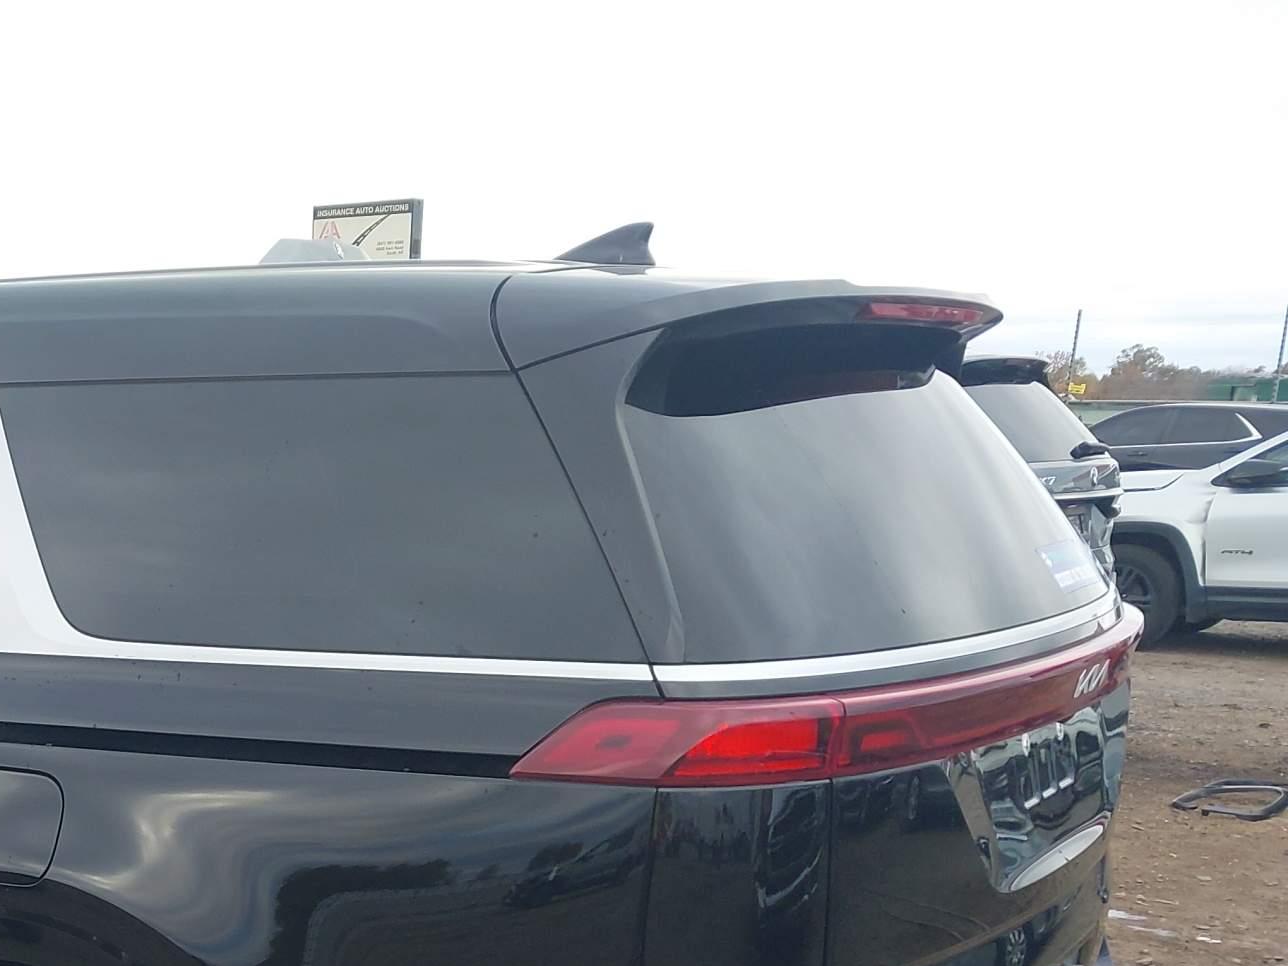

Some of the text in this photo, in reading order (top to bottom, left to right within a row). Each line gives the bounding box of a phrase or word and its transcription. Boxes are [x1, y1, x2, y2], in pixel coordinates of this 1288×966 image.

[316, 203, 409, 217] INSURANCE AUTO AUCTIONS
